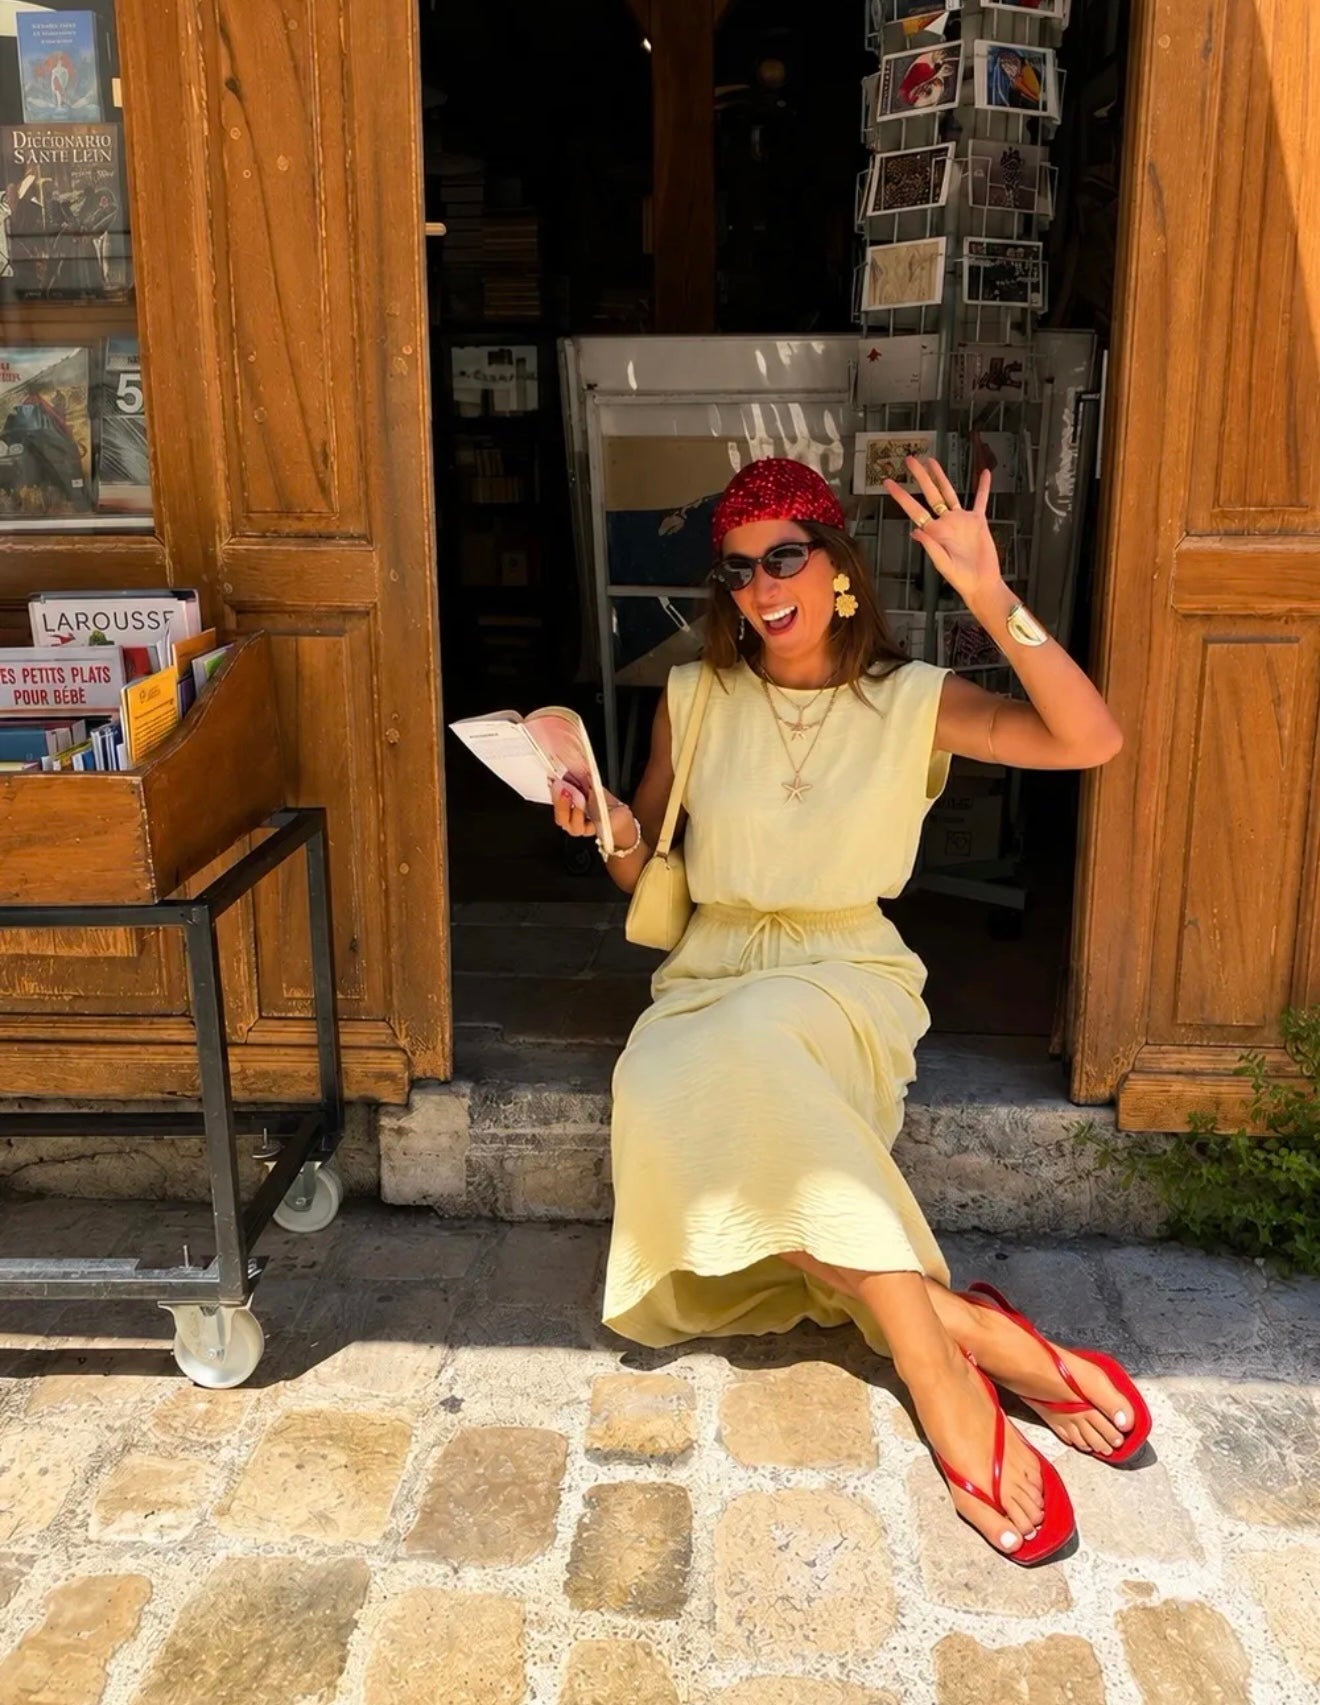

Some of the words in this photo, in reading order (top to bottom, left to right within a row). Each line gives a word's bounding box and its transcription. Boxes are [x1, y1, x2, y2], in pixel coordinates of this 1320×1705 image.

[116, 373, 143, 413] 5
[0, 668, 16, 684] ES
[22, 667, 65, 684] PETITS
[71, 666, 111, 683] PLATS
[14, 689, 49, 705] POUR
